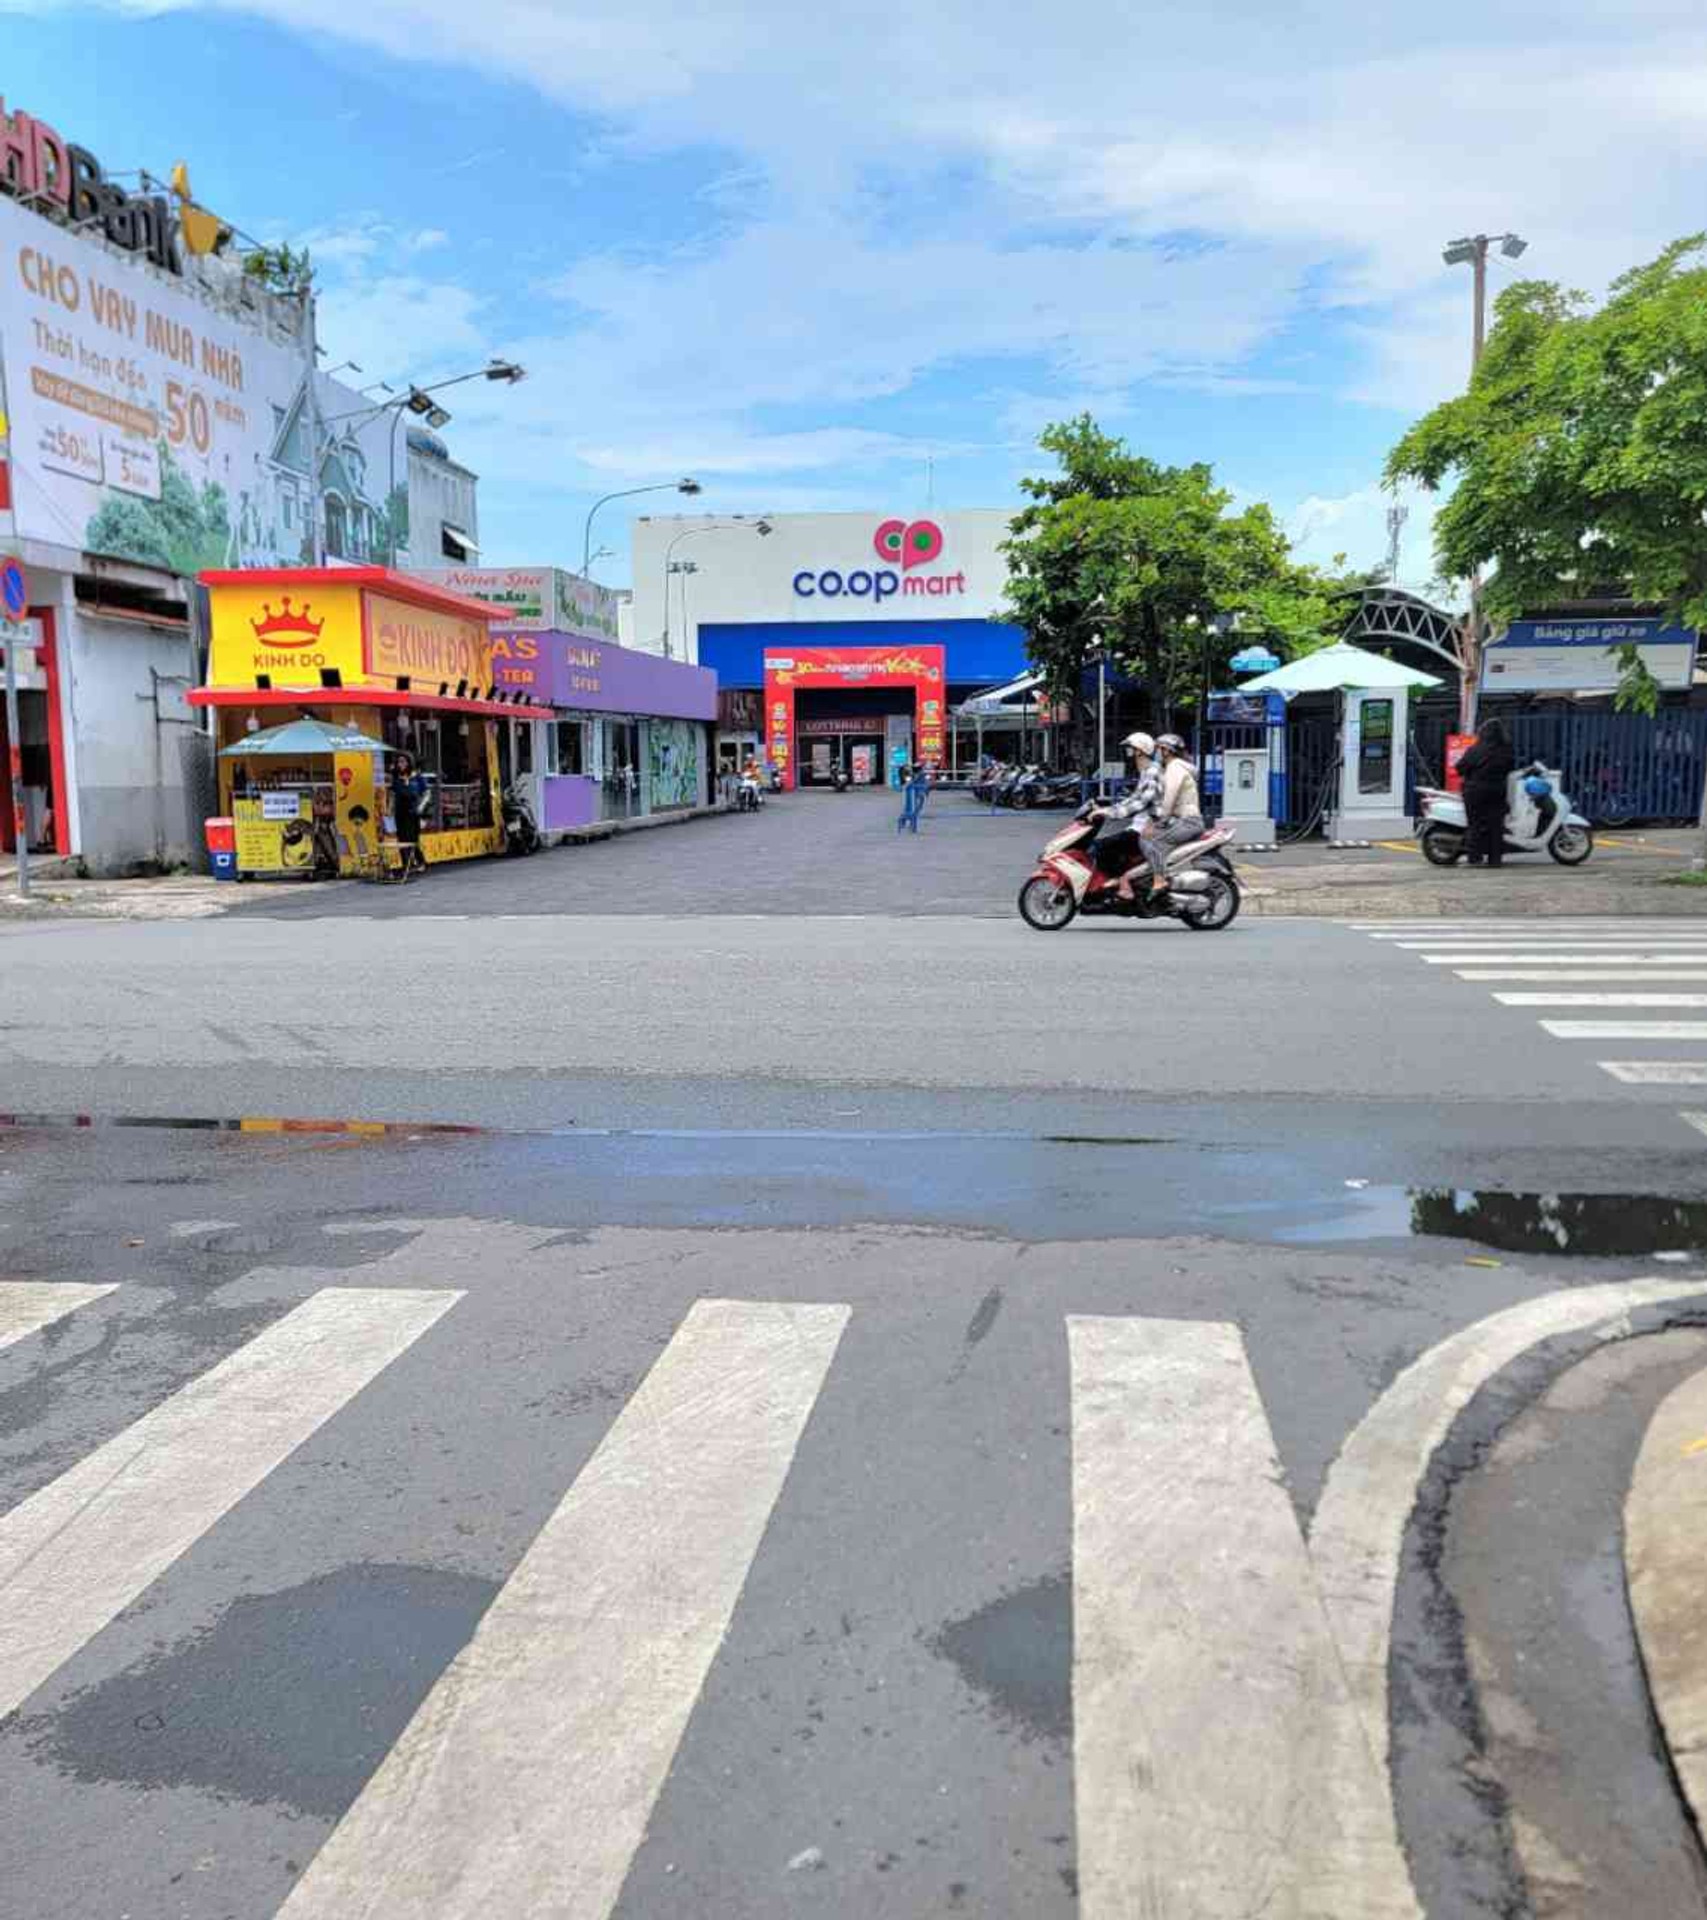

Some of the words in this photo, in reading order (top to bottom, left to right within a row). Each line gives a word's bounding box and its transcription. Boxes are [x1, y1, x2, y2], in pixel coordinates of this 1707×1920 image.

[0, 95, 182, 277] HDBank
[19, 246, 80, 313] CHO
[88, 275, 137, 339] VAY
[144, 309, 195, 368] MUA
[202, 335, 244, 392] NHÀ
[165, 378, 209, 453] 50
[253, 653, 296, 669] KINH
